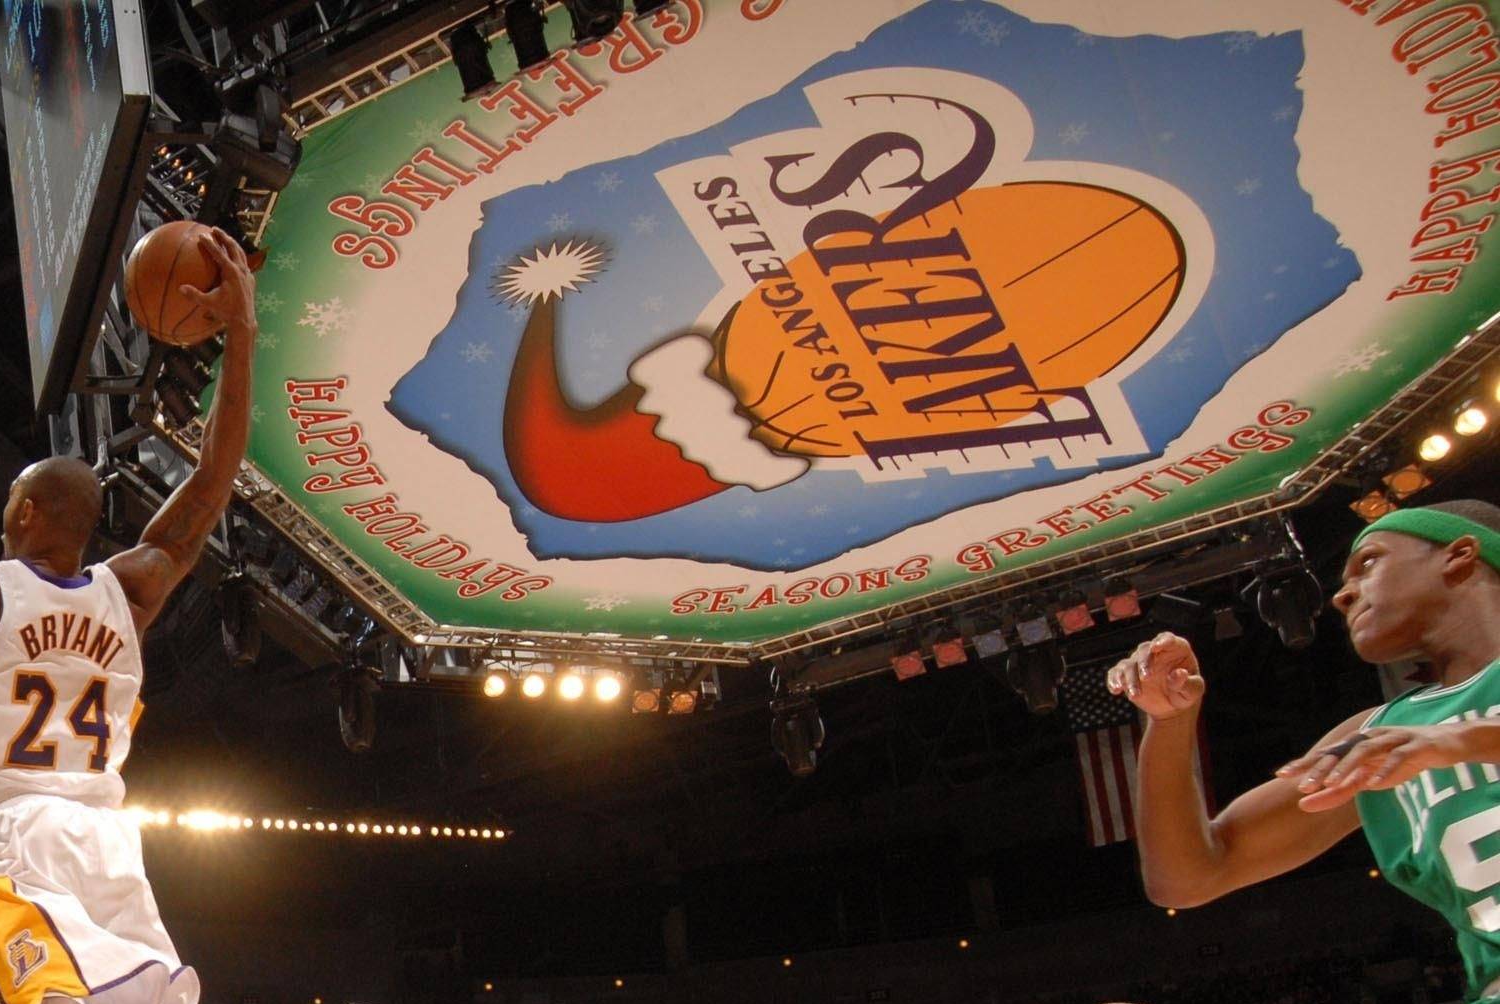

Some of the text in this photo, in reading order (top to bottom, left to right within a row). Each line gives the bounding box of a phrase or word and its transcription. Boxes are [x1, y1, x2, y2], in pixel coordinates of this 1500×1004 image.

[693, 175, 879, 421] LOS ANGELES
[769, 92, 1113, 472] LAKERS
[284, 375, 554, 603] HAPPY HOLIDAYS
[669, 398, 1316, 617] SEASONS GREETINGS
[3, 669, 112, 774] 24
[19, 612, 125, 670] BRYANT
